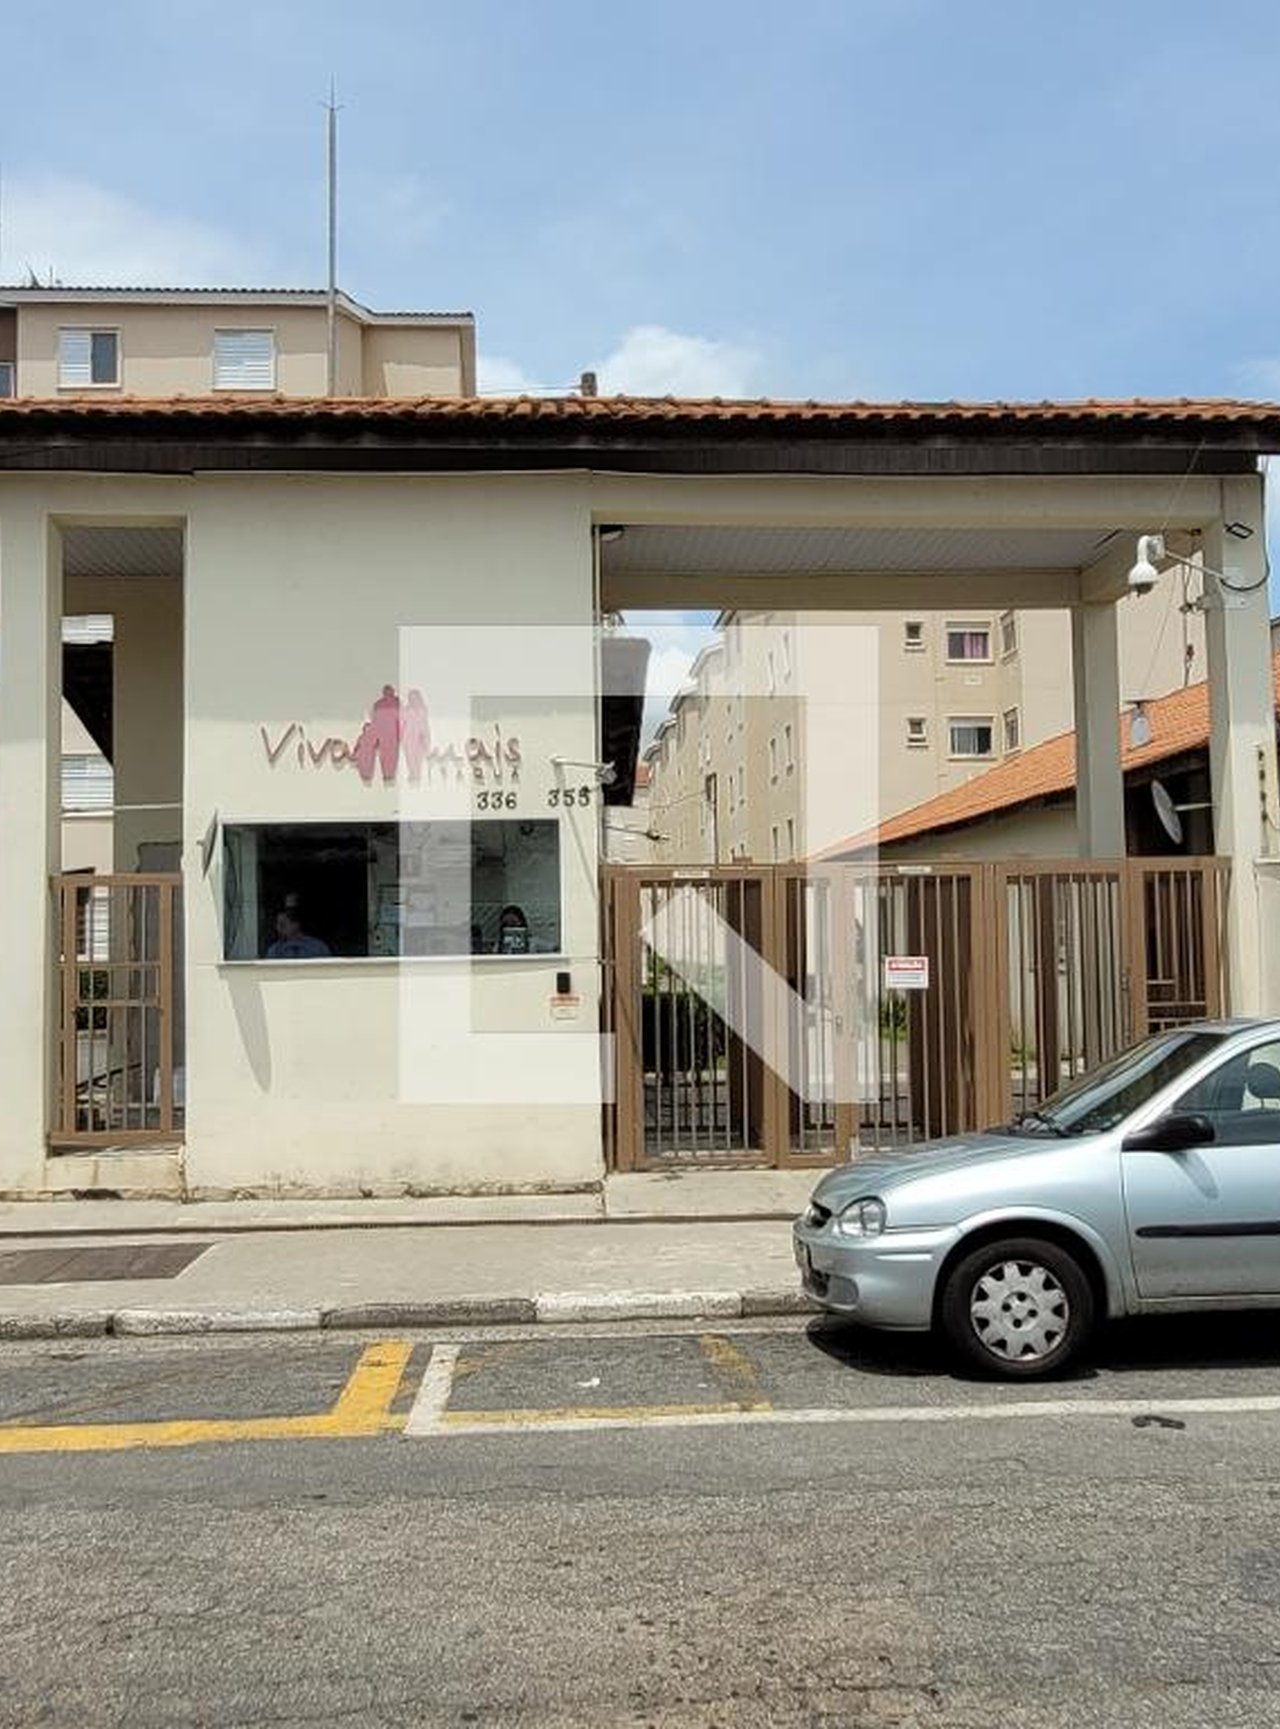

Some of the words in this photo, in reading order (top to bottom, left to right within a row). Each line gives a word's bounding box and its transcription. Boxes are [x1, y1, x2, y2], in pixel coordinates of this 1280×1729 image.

[261, 723, 359, 768] Viva
[476, 790, 518, 811] 336
[546, 788, 591, 809] 355
